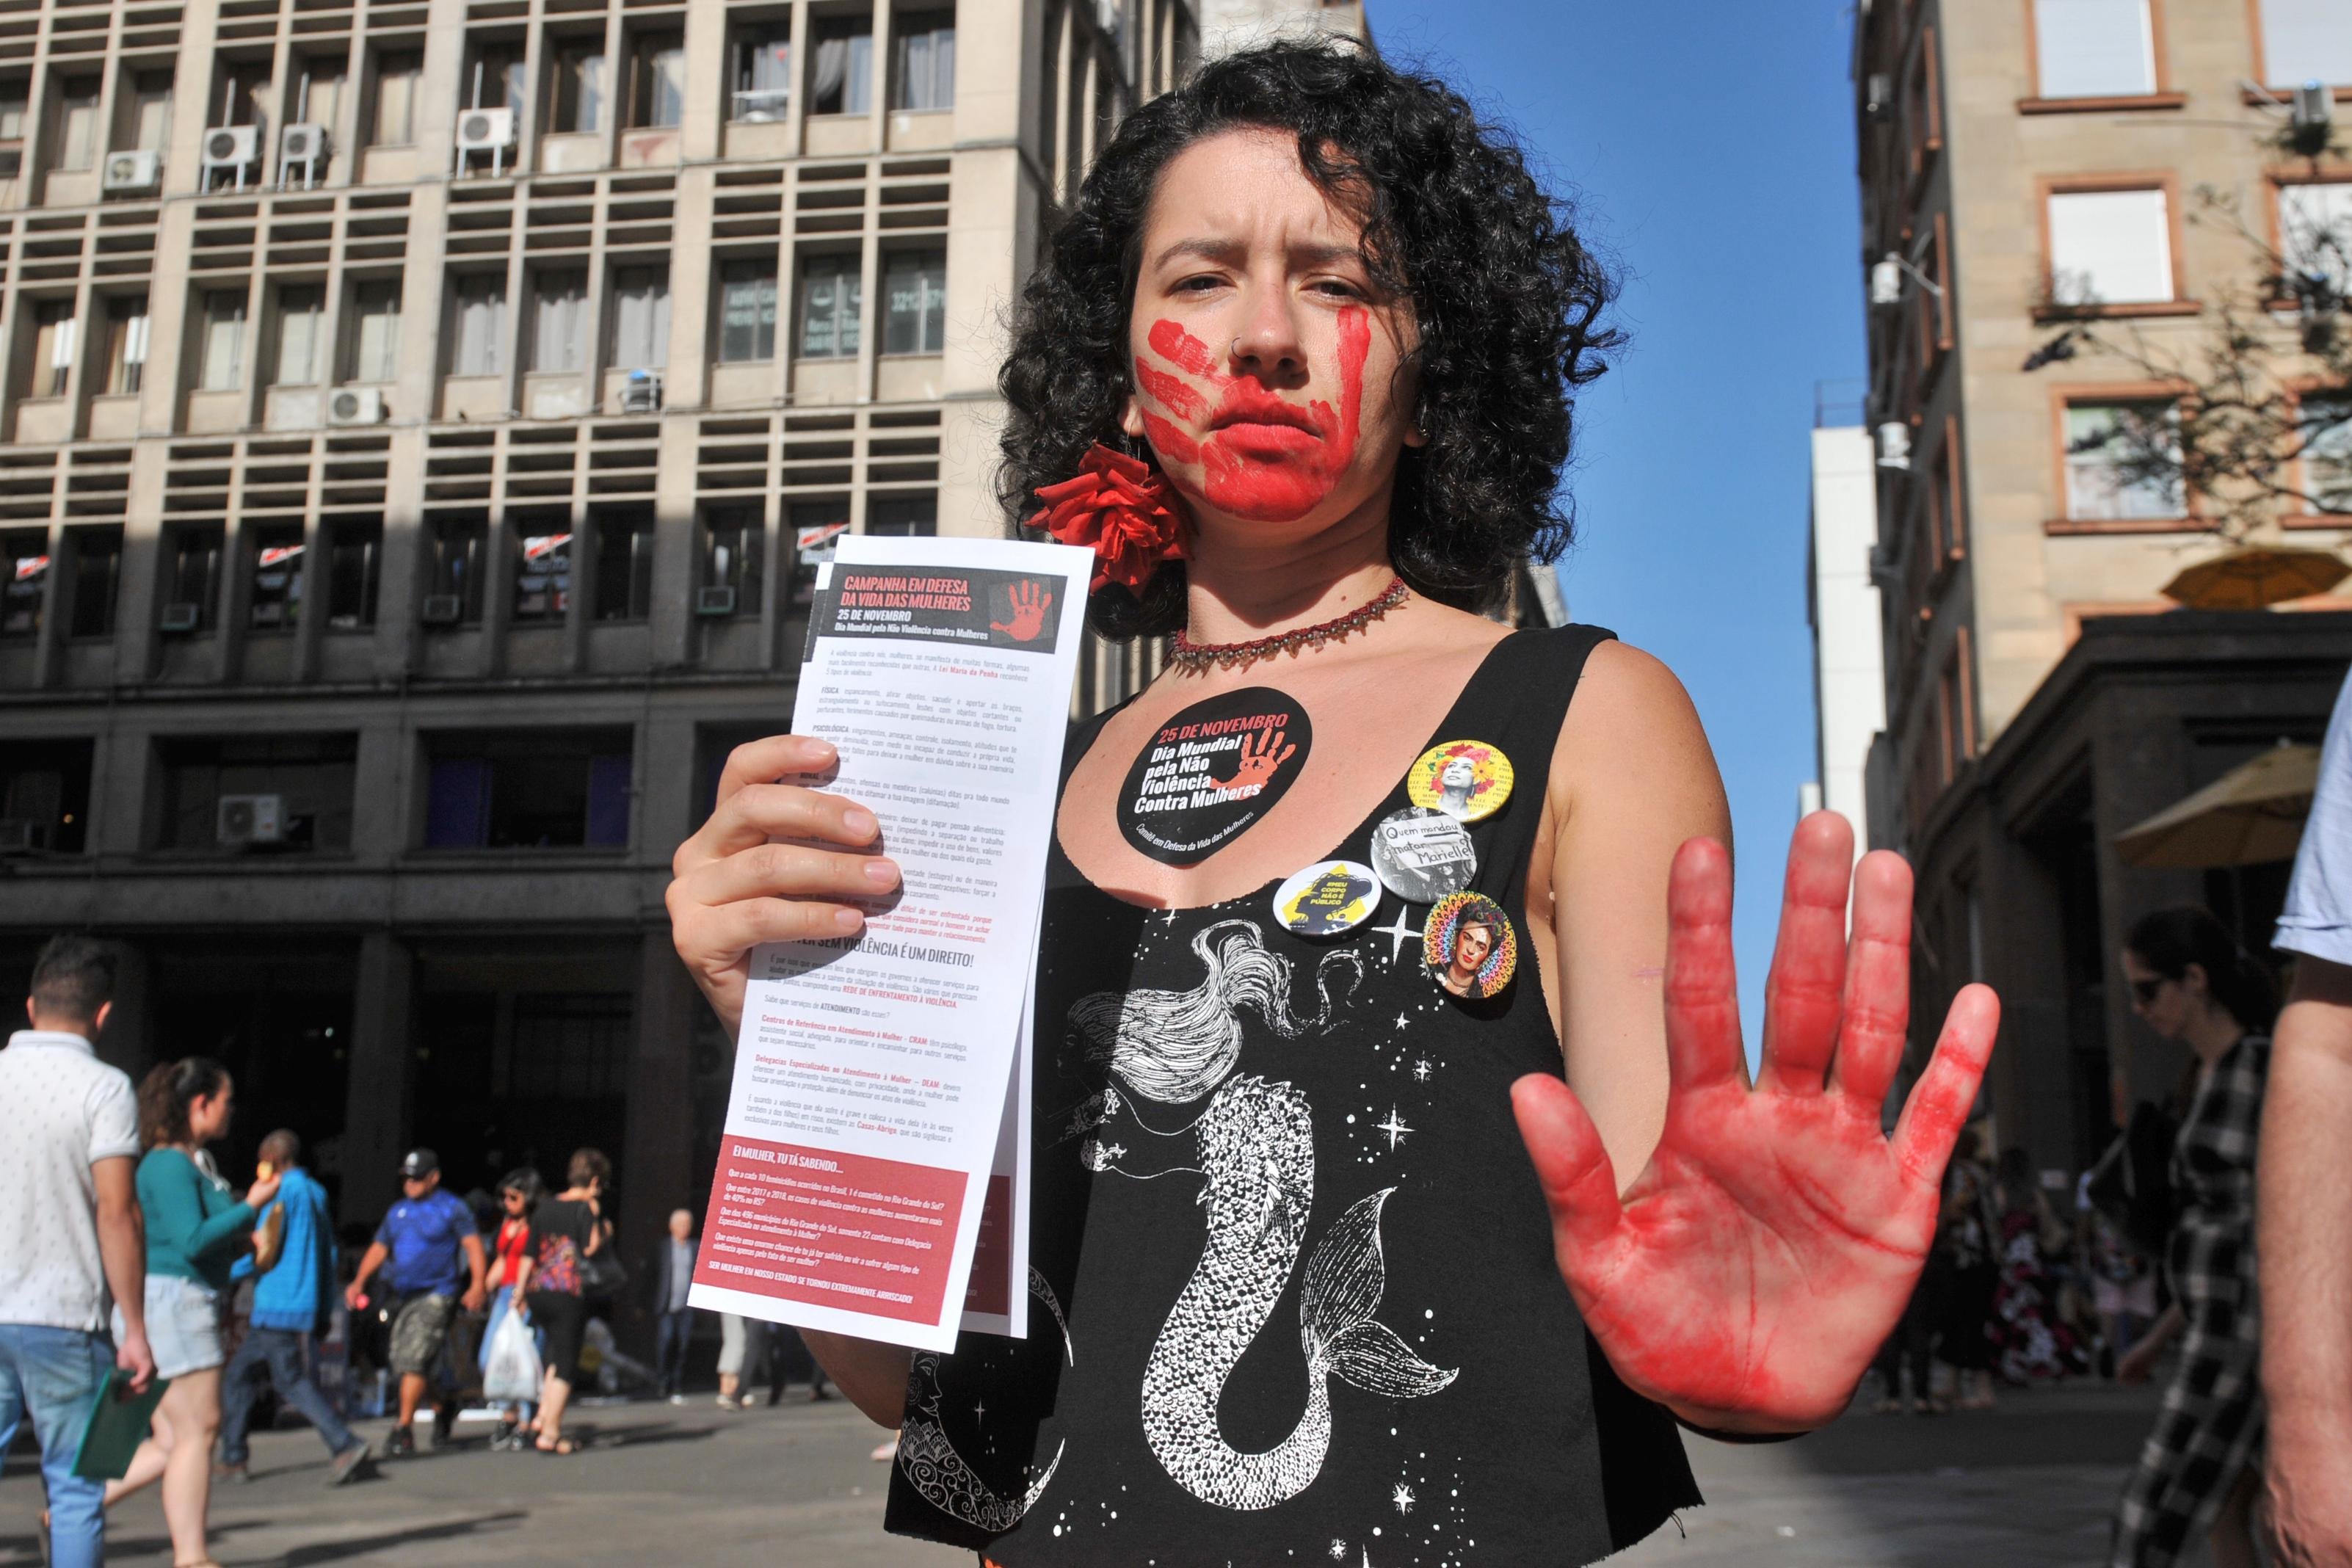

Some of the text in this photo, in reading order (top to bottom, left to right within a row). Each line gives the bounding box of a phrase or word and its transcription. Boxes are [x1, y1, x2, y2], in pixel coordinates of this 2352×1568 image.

[844, 576, 968, 594] CAMPANHA EM DEFESA
[841, 592, 971, 611] DA VIDA DAS MULHERES
[838, 609, 912, 623] 25 DE NOVEMBRO
[835, 623, 989, 641] Dia Mundial pela Não Violência contra Mulheres
[950, 666, 968, 675] Maria
[979, 669, 998, 678] Penha
[1158, 714, 1288, 744] 25 DE NOVEMBRO
[1150, 735, 1243, 763] Dia Mundial
[1144, 756, 1210, 780] pela Não
[1140, 773, 1211, 796] Violência
[1134, 783, 1263, 814] Contra Mulheres
[1136, 811, 1254, 852] Comitê em Defesa da Vida das Mulheres
[1386, 823, 1458, 840] Quem mandou
[1394, 841, 1426, 855] matar
[1418, 838, 1473, 864] Marielle?
[818, 937, 841, 949] SEM
[844, 937, 899, 957] VIOLÊNCIA
[900, 942, 908, 959] É
[908, 946, 926, 962] UM
[928, 948, 975, 968] DIREITO!
[764, 994, 778, 1003] Sabe
[791, 1000, 812, 1009] serviços
[821, 1002, 860, 1015] ATENDIMENTO
[843, 985, 857, 995] REDE
[859, 987, 867, 995] DE
[868, 989, 918, 1003] ENFRENTAMENTO
[762, 1015, 785, 1024] Centros
[795, 1020, 826, 1030] Referência
[838, 1026, 875, 1037] Atendimento
[882, 1031, 903, 1041] Mulher
[755, 1053, 787, 1066] Delegacias
[789, 1059, 830, 1072] Especializadas
[843, 1067, 881, 1079] Atendimento
[890, 1074, 912, 1084] Mulher
[733, 1145, 741, 1156] EI
[741, 1147, 777, 1162] MULHER,
[777, 1153, 788, 1164] TU
[788, 1154, 799, 1166] TÁ
[724, 1192, 731, 1200] de
[732, 1194, 746, 1202] 40%
[753, 1197, 765, 1205] RS?
[728, 1169, 740, 1177] Que
[745, 1171, 757, 1180] cada
[758, 1173, 766, 1181] 10
[766, 1175, 796, 1186] feminicídios
[797, 1180, 821, 1190] ocorridos
[831, 1185, 847, 1194] Brasil,
[858, 1189, 883, 1200] cometido
[892, 1195, 901, 1203] Rio
[902, 1197, 922, 1207] Grande
[931, 1201, 944, 1211] Sul?
[725, 1183, 736, 1191] Que
[737, 1185, 752, 1194] entre
[752, 1188, 766, 1196] 2017
[772, 1191, 787, 1199] 2018,
[819, 1199, 842, 1208] violência
[843, 1202, 860, 1212] contra
[868, 1207, 893, 1217] mulheres
[895, 1211, 929, 1223] aumentaram
[929, 1217, 943, 1225] mais
[721, 1207, 731, 1215] Que
[732, 1209, 741, 1217] dos
[754, 1213, 781, 1224] municípios
[782, 1217, 789, 1225] do
[790, 1219, 799, 1227] Rio
[799, 1220, 819, 1230] Grande
[839, 1227, 861, 1237] somente
[863, 1230, 871, 1238] 22
[871, 1233, 891, 1242] contam
[905, 1238, 932, 1249] Delegacia
[708, 1260, 913, 1303] SER MULHER EM NOSSO ESTADO SE TORNOU EXTREMAMENTE ARRISCADO!
